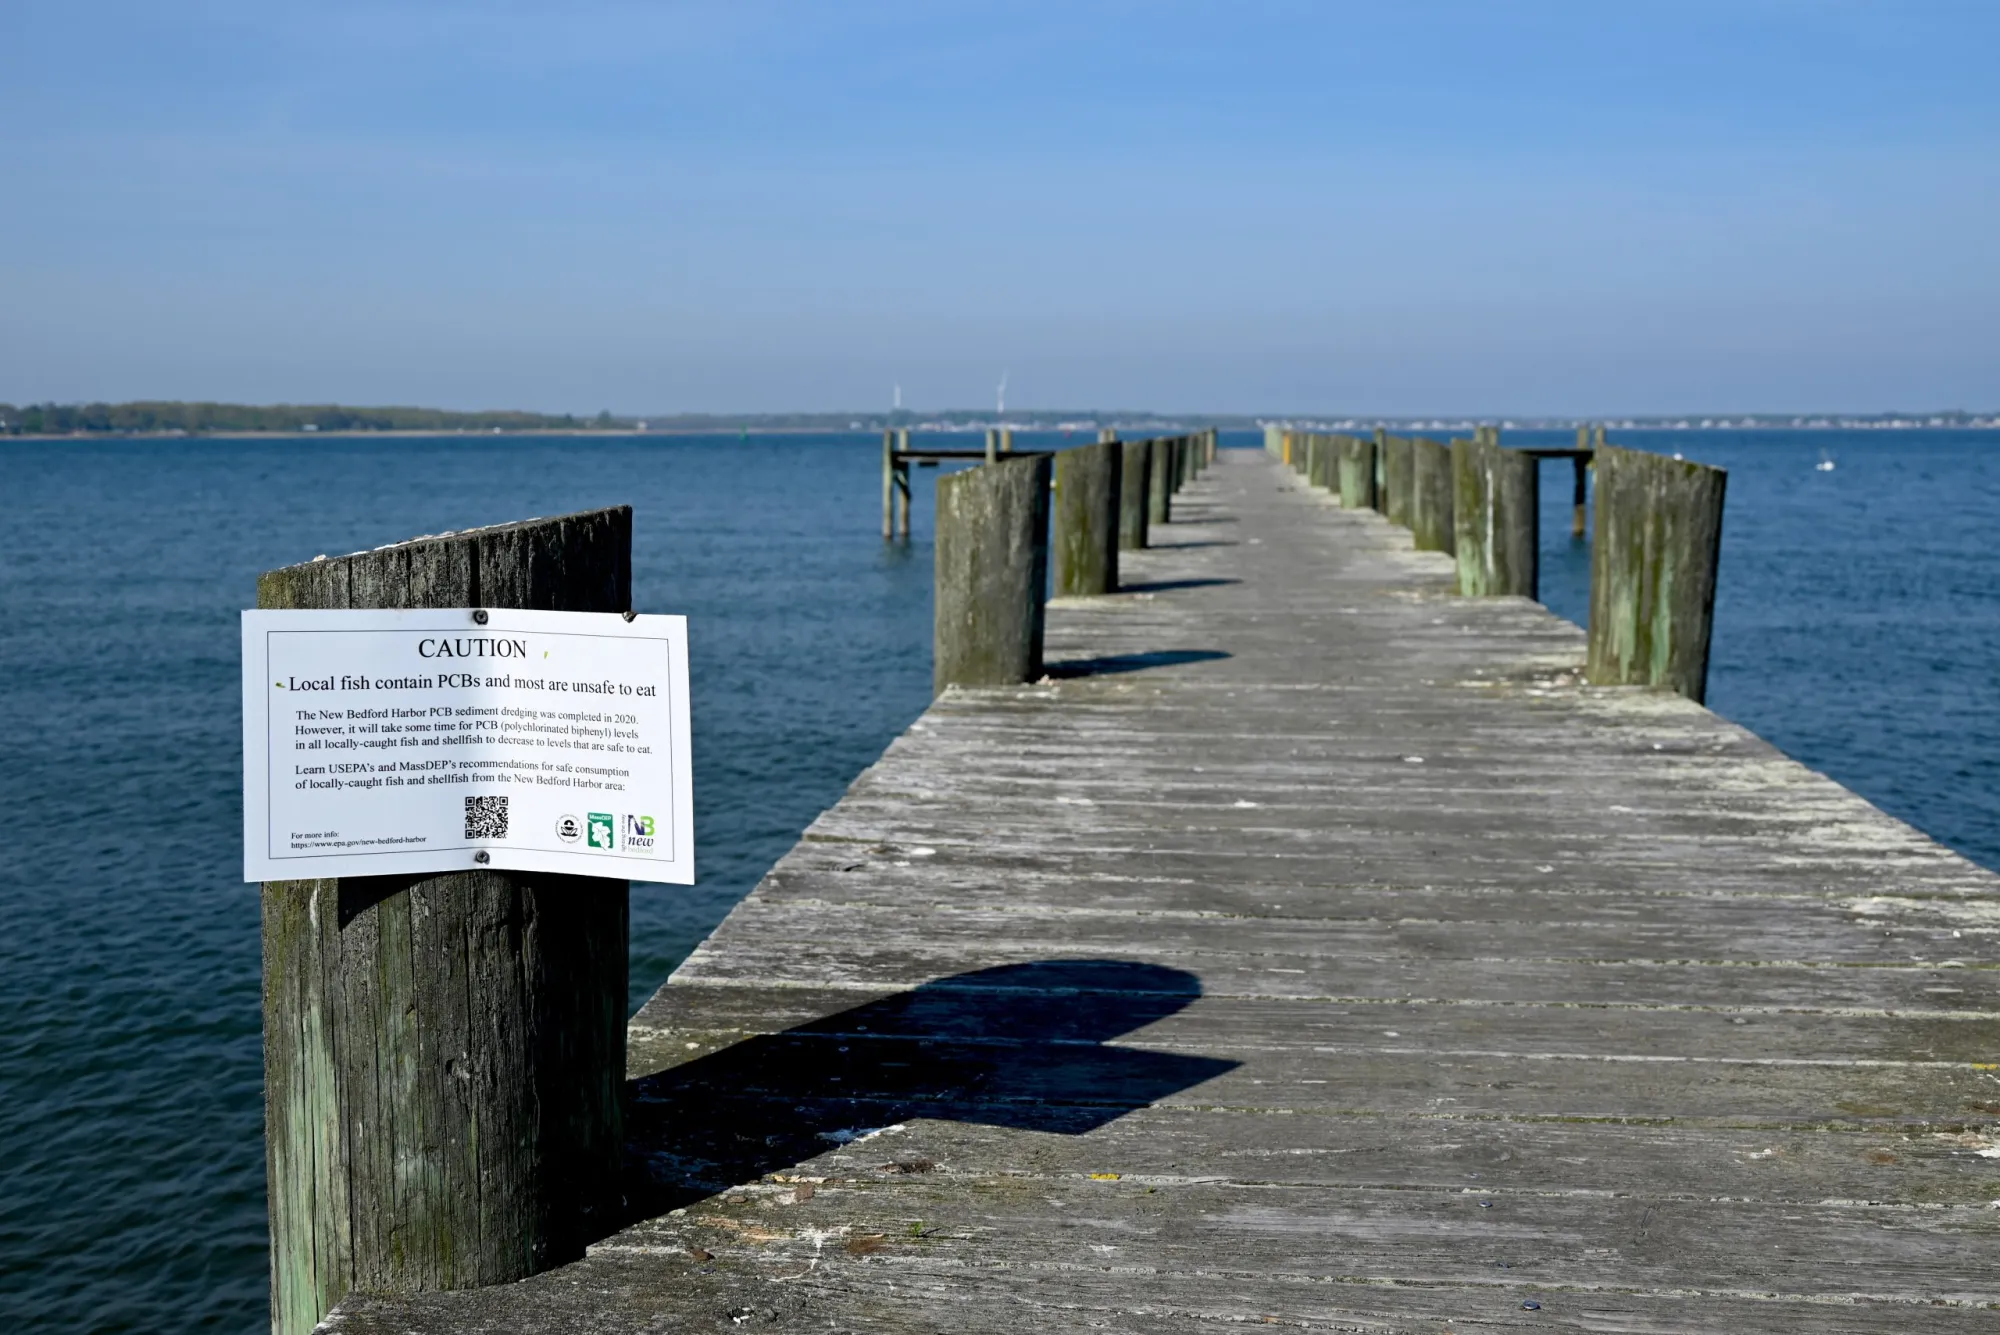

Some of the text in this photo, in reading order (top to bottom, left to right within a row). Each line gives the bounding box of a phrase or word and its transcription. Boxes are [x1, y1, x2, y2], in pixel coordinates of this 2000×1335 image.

[418, 638, 526, 659] CAUTION
[289, 673, 656, 697] Local fish contain PCBs and most are unsafe to eat
[295, 710, 316, 720] The
[319, 710, 344, 720] New
[346, 708, 389, 720] Bedford
[391, 708, 427, 718] Harbor
[429, 707, 453, 717] PCB
[455, 706, 499, 716] sediment
[500, 706, 538, 720] dredging
[558, 711, 602, 723] completed
[604, 713, 612, 723] in
[614, 714, 638, 724] 2020.
[295, 720, 639, 739] However, it will take some time for PCB (polychlorinated biphenyl) levels
[295, 734, 652, 754] in all locally-caught fish and shellfish to decrease to levels that are safe to eat.
[295, 759, 630, 778] Learn USEPA's and MassDEP's recommendations for safe consumption
[295, 772, 625, 791] of locally-caught fish and shellfish from the New Bedford Harbor area:
[290, 836, 427, 850] https://www.epa.gov/new-bedford-harbor
[291, 832, 304, 840] For
[324, 830, 340, 838] info:
[628, 836, 654, 847] new
